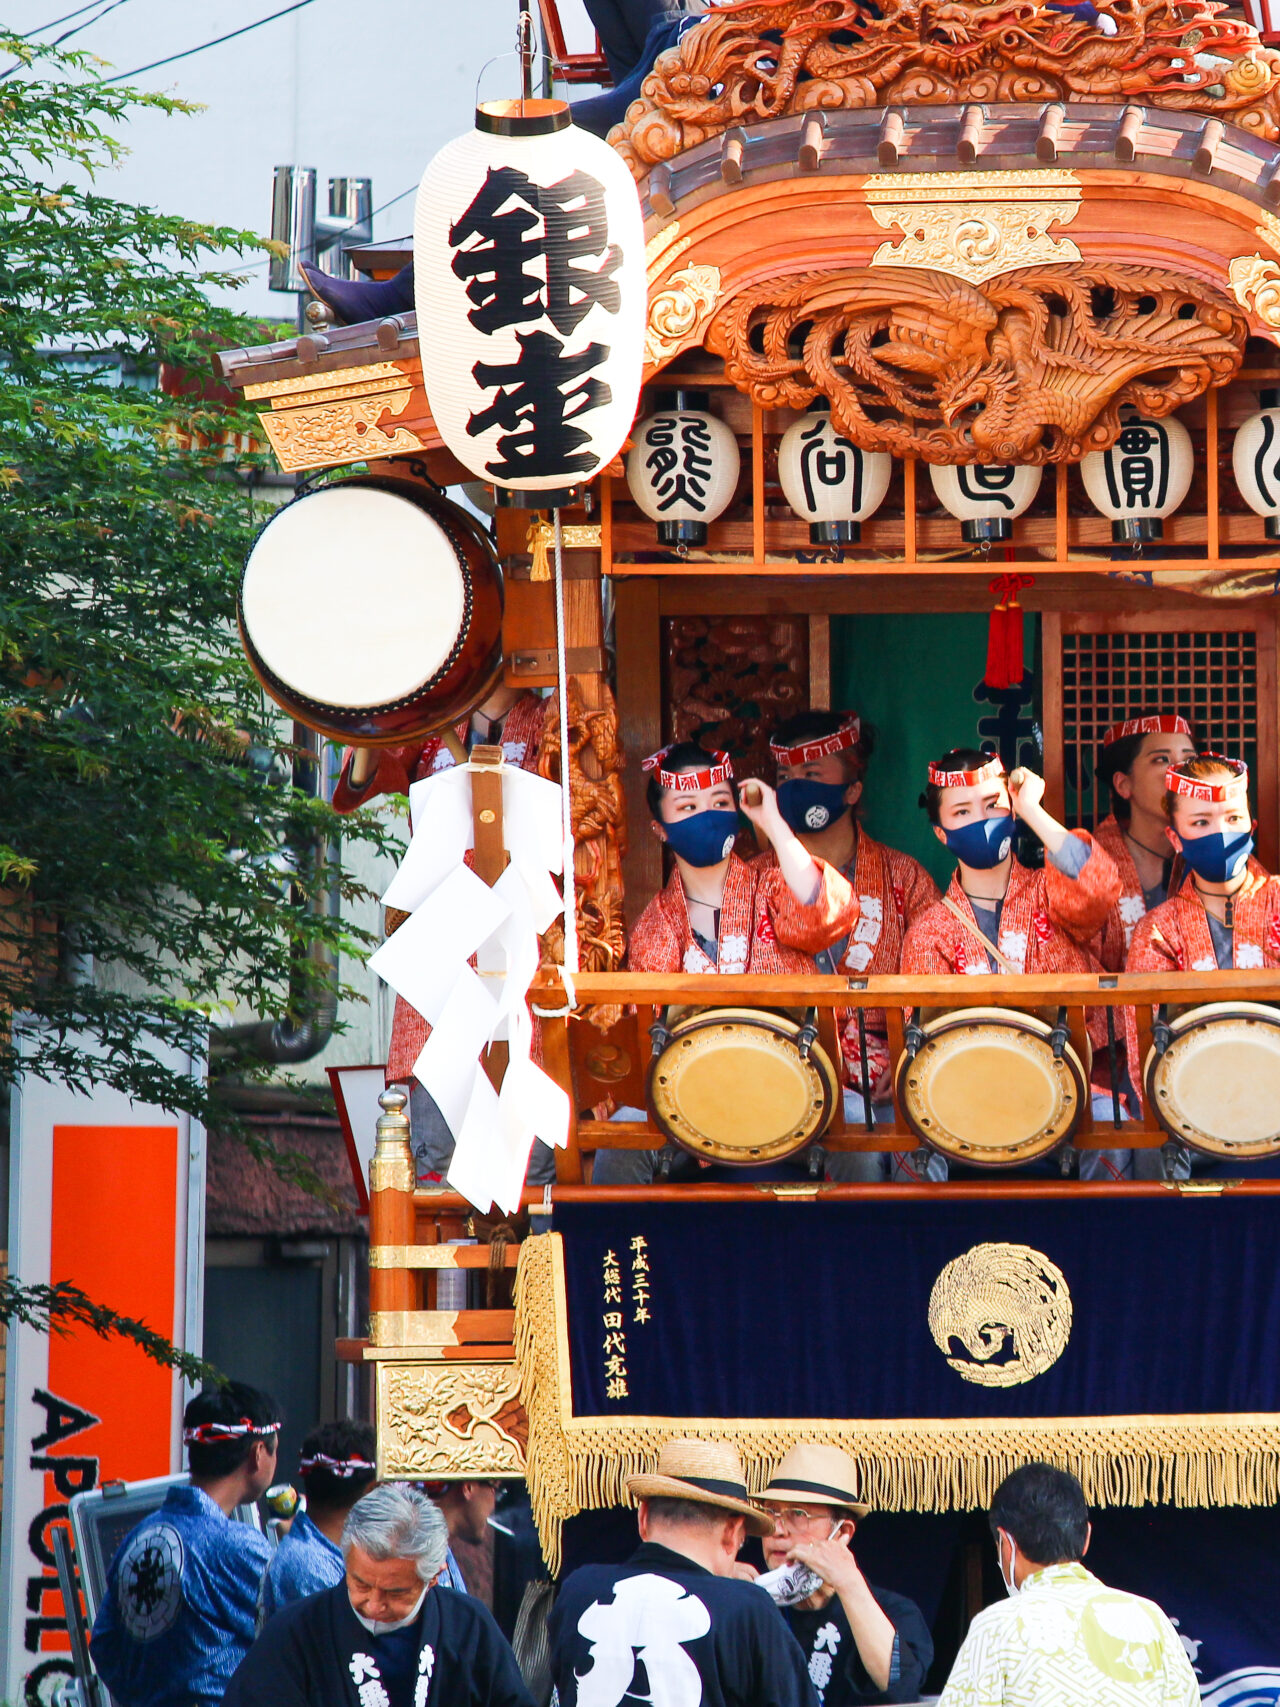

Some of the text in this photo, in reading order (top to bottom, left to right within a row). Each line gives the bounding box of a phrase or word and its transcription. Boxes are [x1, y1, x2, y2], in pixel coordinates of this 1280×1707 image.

[448, 166, 625, 480] 銀座
[602, 1249, 630, 1400] 大総代 田代充雄
[629, 1235, 652, 1325] 平成三十年
